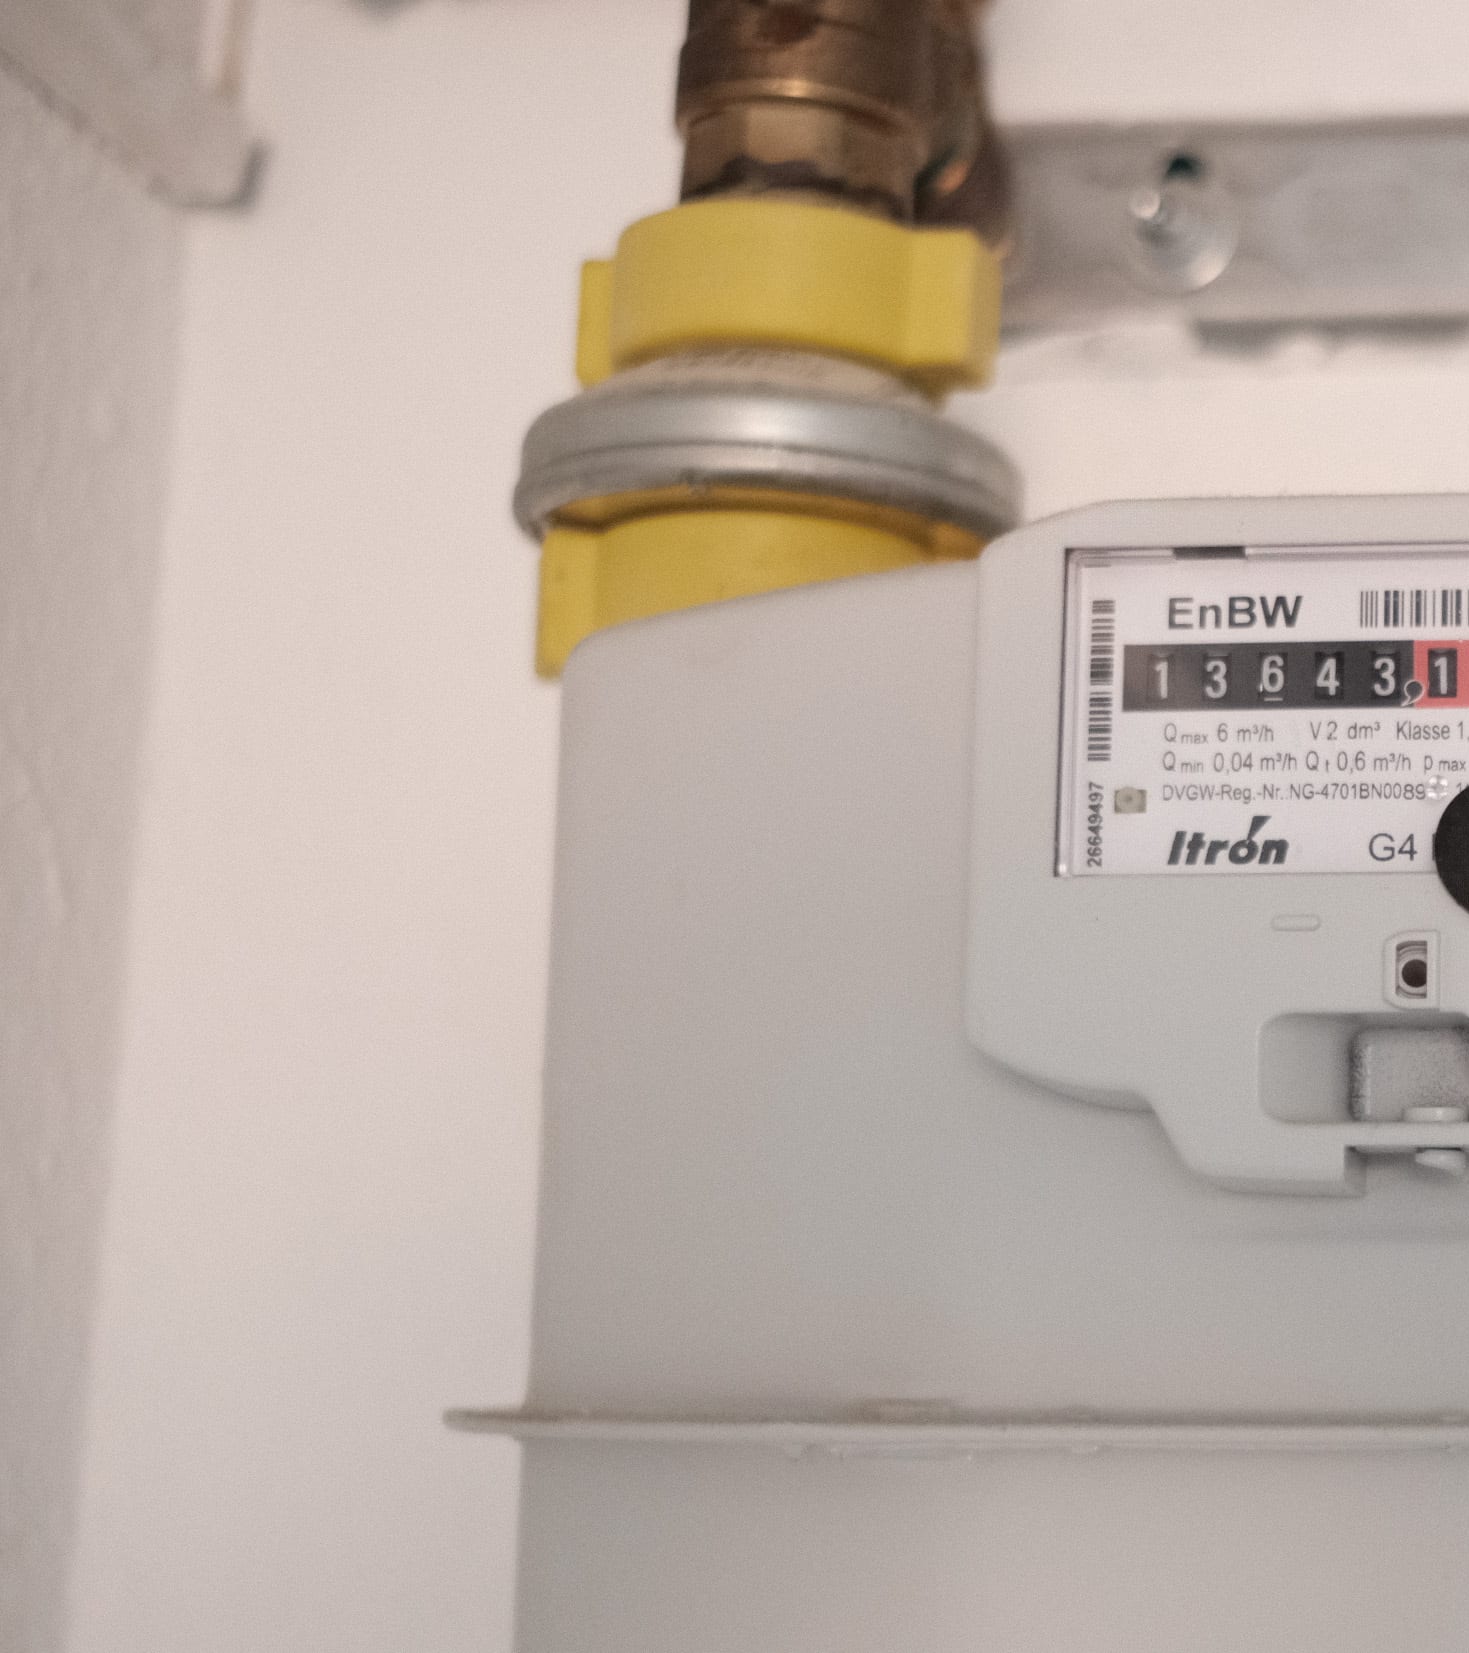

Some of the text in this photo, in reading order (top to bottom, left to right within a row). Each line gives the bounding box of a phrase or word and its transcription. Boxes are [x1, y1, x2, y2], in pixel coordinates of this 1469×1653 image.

[1167, 595, 1303, 629] EnBW
[1217, 723, 1229, 743] 6
[1396, 720, 1450, 741] Klasse
[1213, 751, 1254, 776] 0,04
[1336, 750, 1367, 774] 0,6
[1087, 781, 1103, 868] 26649497
[1368, 833, 1418, 862] G4
